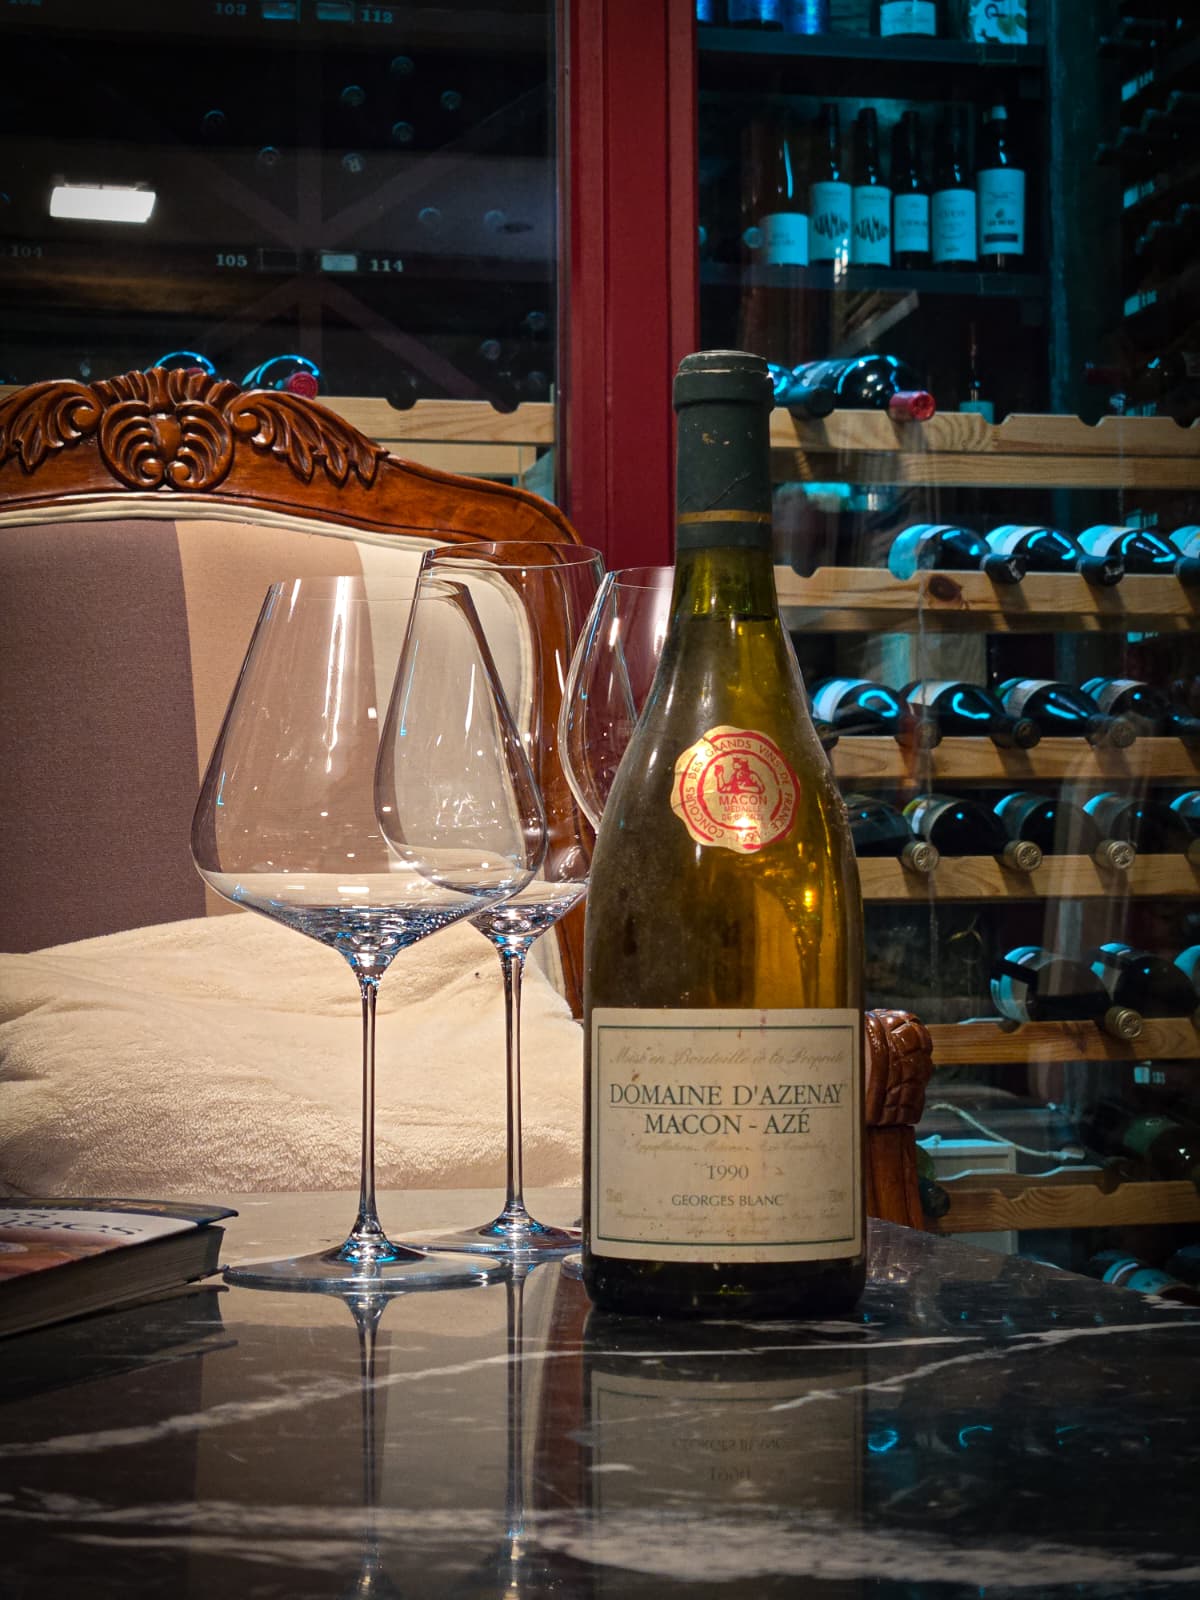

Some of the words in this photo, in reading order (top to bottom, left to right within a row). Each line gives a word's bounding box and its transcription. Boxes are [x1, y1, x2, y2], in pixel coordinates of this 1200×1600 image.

[360, 9, 393, 24] 112
[216, 254, 248, 268] 105
[370, 258, 403, 272] 114
[759, 744, 781, 767] VINS
[688, 761, 703, 781] DES
[780, 771, 791, 785] DE
[718, 795, 768, 806] MACON
[685, 786, 725, 838] CONCOURS
[771, 791, 793, 832] FRANCE
[610, 1083, 723, 1106] DOMAINE
[733, 1083, 844, 1106] D'AZENAY
[644, 1113, 742, 1135] MACON
[763, 1107, 810, 1135] AZÉ
[706, 1164, 750, 1181] 1990
[671, 1194, 735, 1207] GEORGES
[738, 1194, 785, 1207] BLANC
